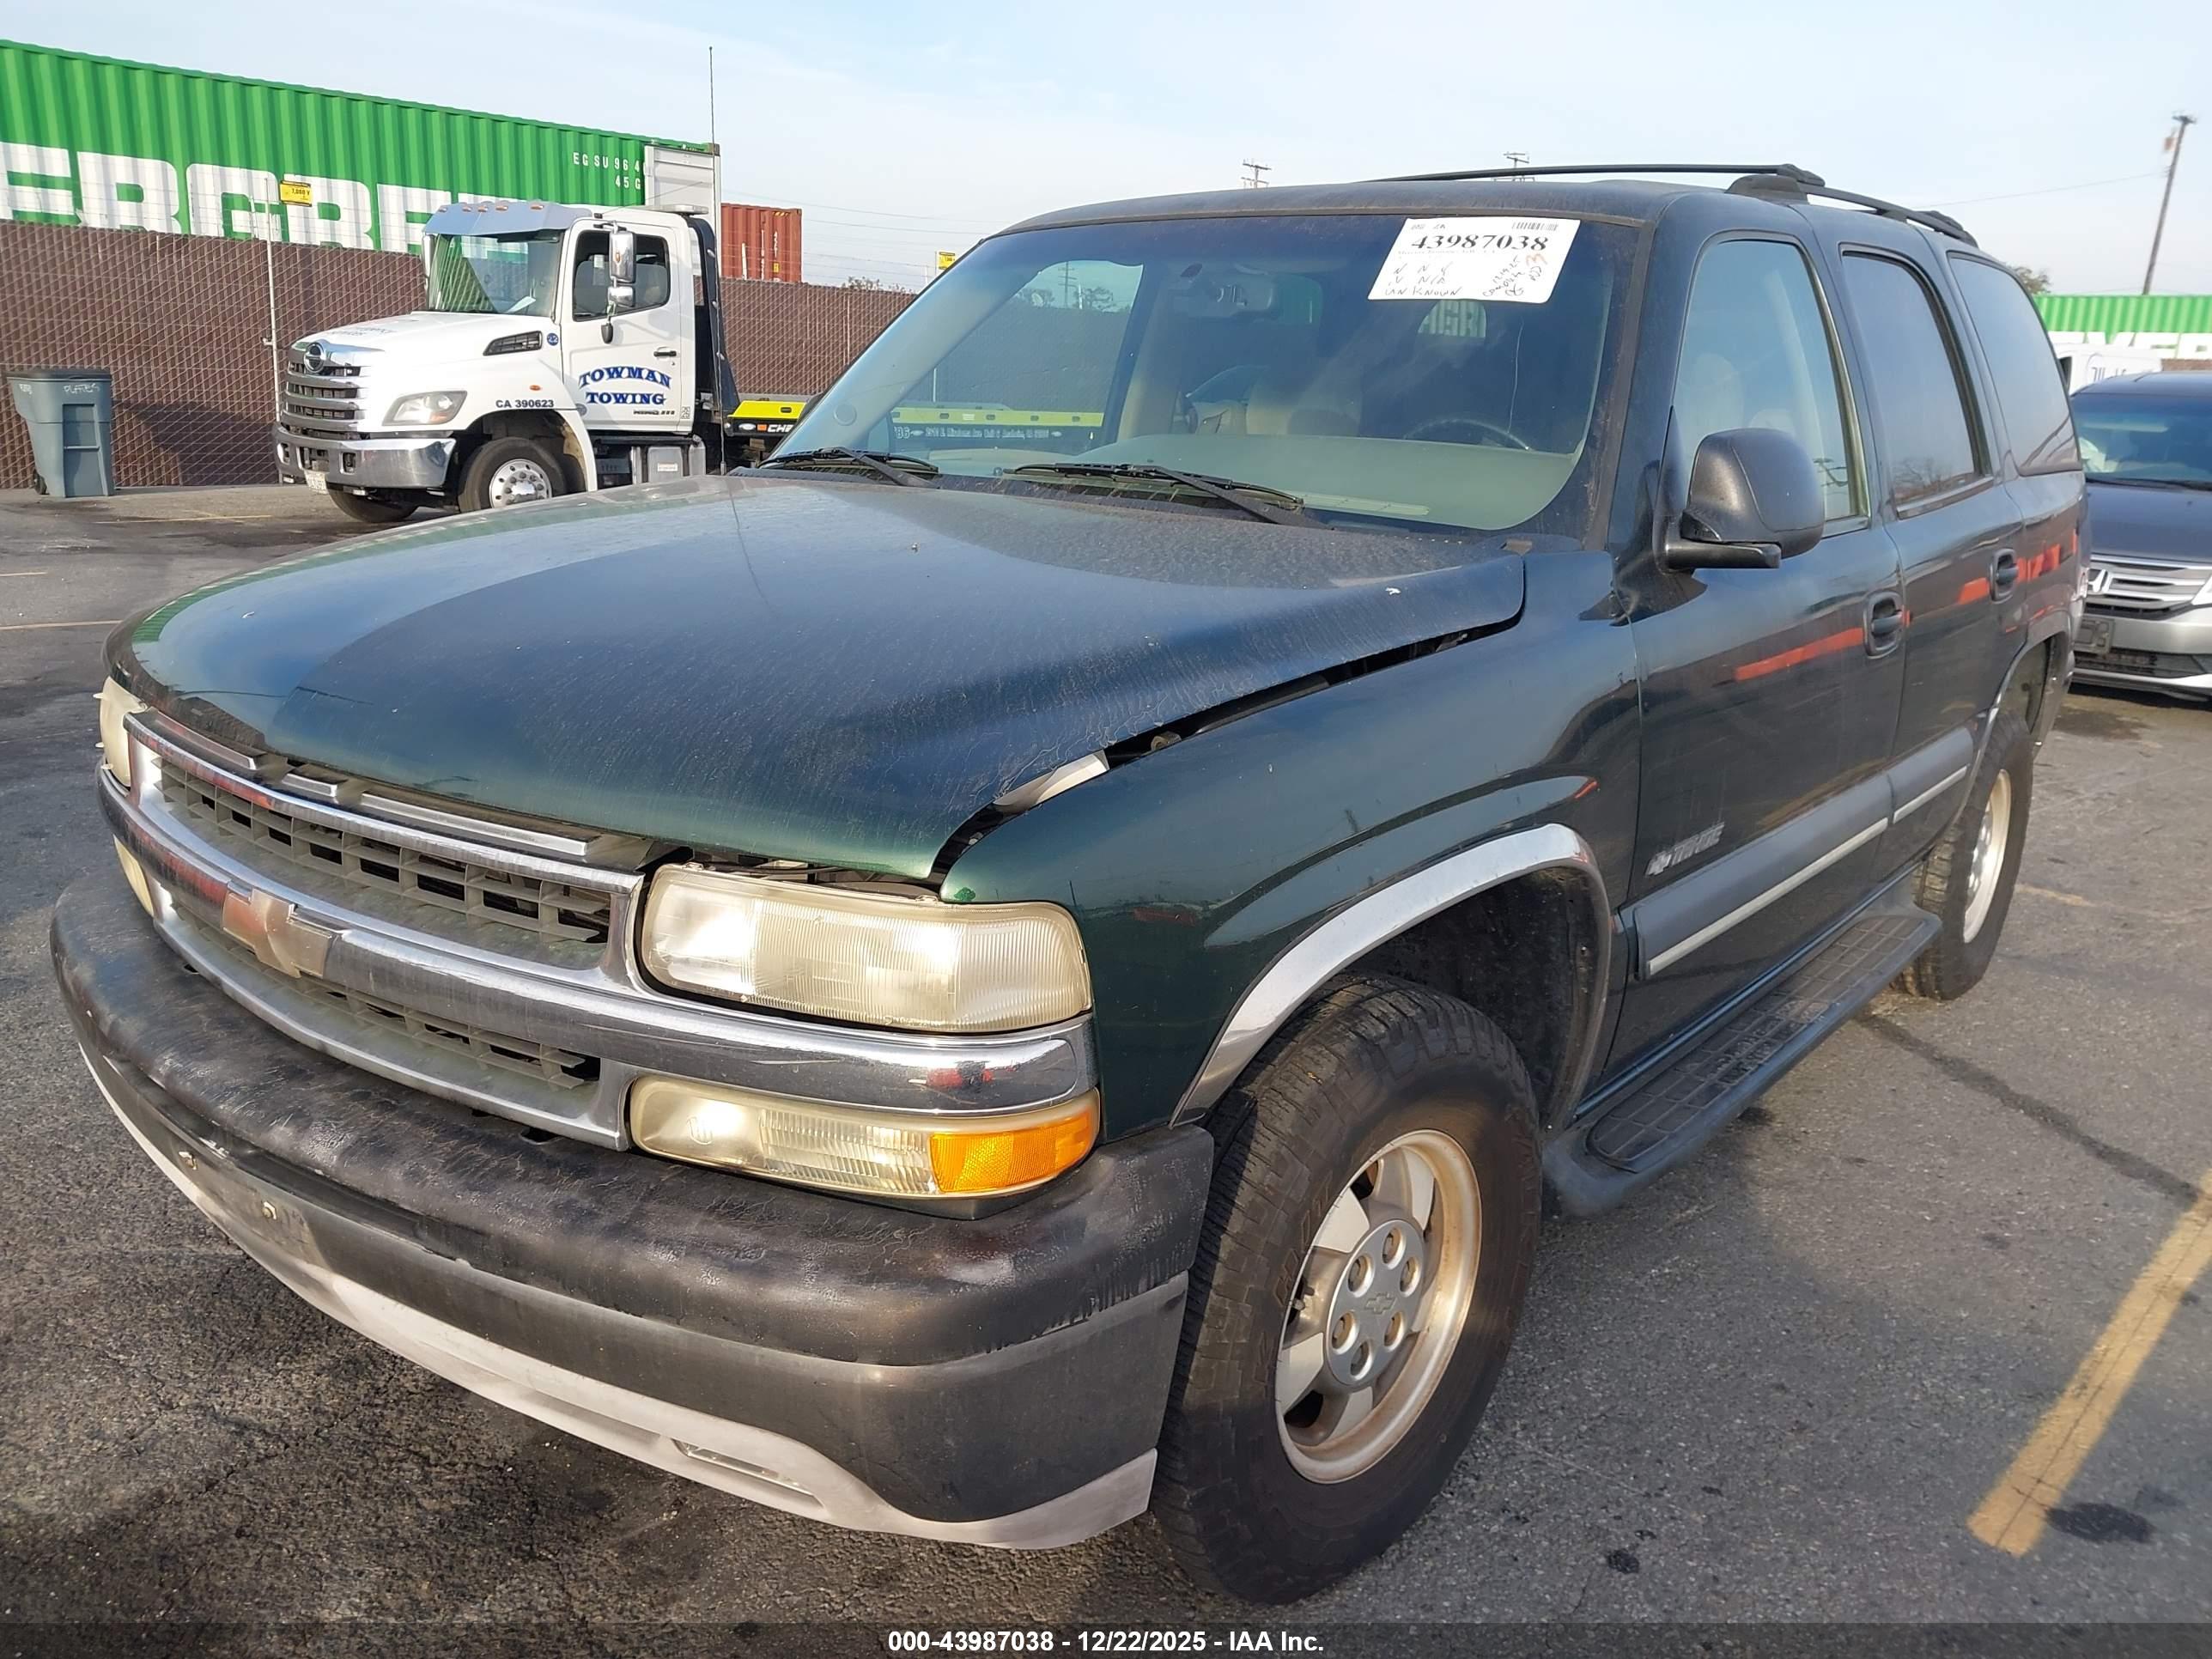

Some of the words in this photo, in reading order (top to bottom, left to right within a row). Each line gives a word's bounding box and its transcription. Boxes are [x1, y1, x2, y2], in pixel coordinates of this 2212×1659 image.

[1412, 234, 1549, 251] 43987038
[579, 366, 672, 390] TOWMAN
[515, 399, 554, 408] 390623
[586, 392, 666, 405] TOWING
